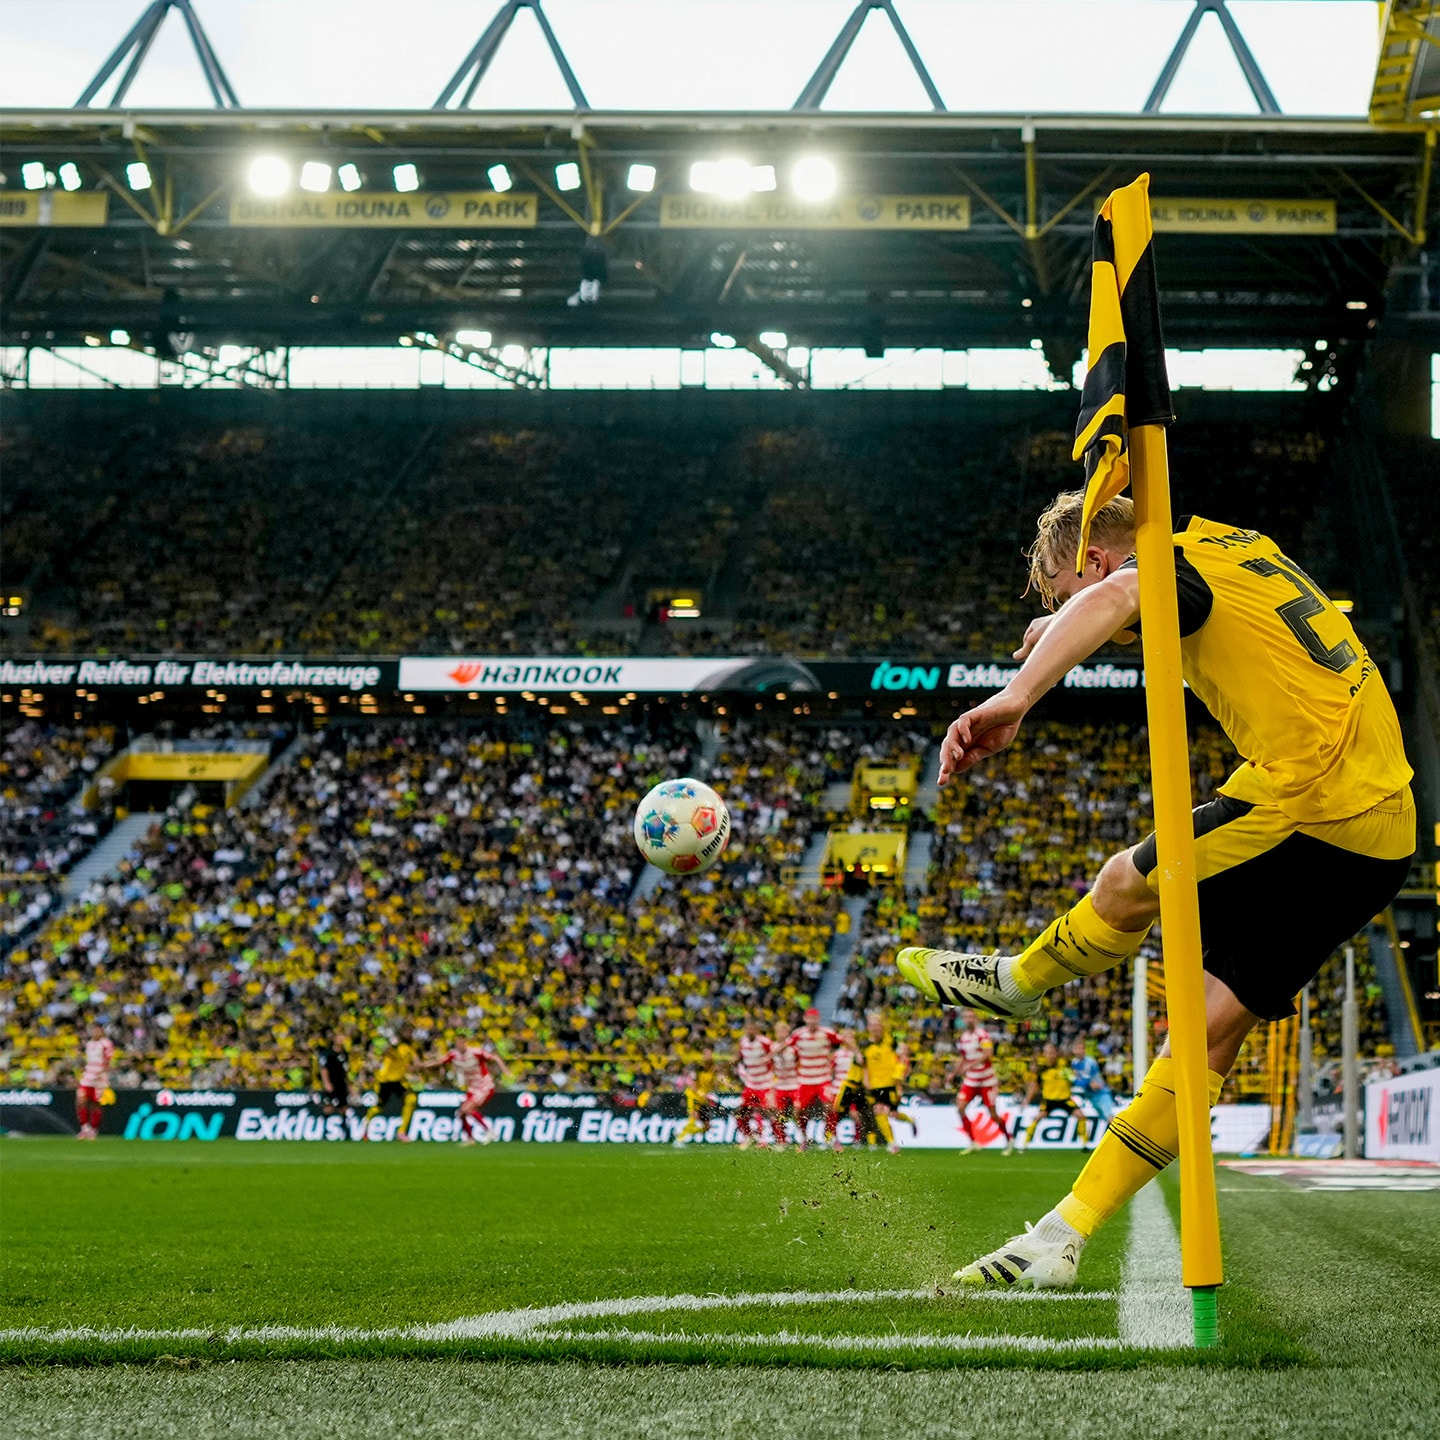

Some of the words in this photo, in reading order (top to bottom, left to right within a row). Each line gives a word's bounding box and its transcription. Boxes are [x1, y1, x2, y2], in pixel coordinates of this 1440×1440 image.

[463, 200, 529, 219] PARK
[895, 202, 963, 221] PARK
[77, 660, 151, 685] Reifen
[153, 661, 191, 685] für
[190, 661, 381, 691] Elektrofahrzeuge
[1064, 664, 1139, 688] Reifen
[521, 1109, 572, 1143] für
